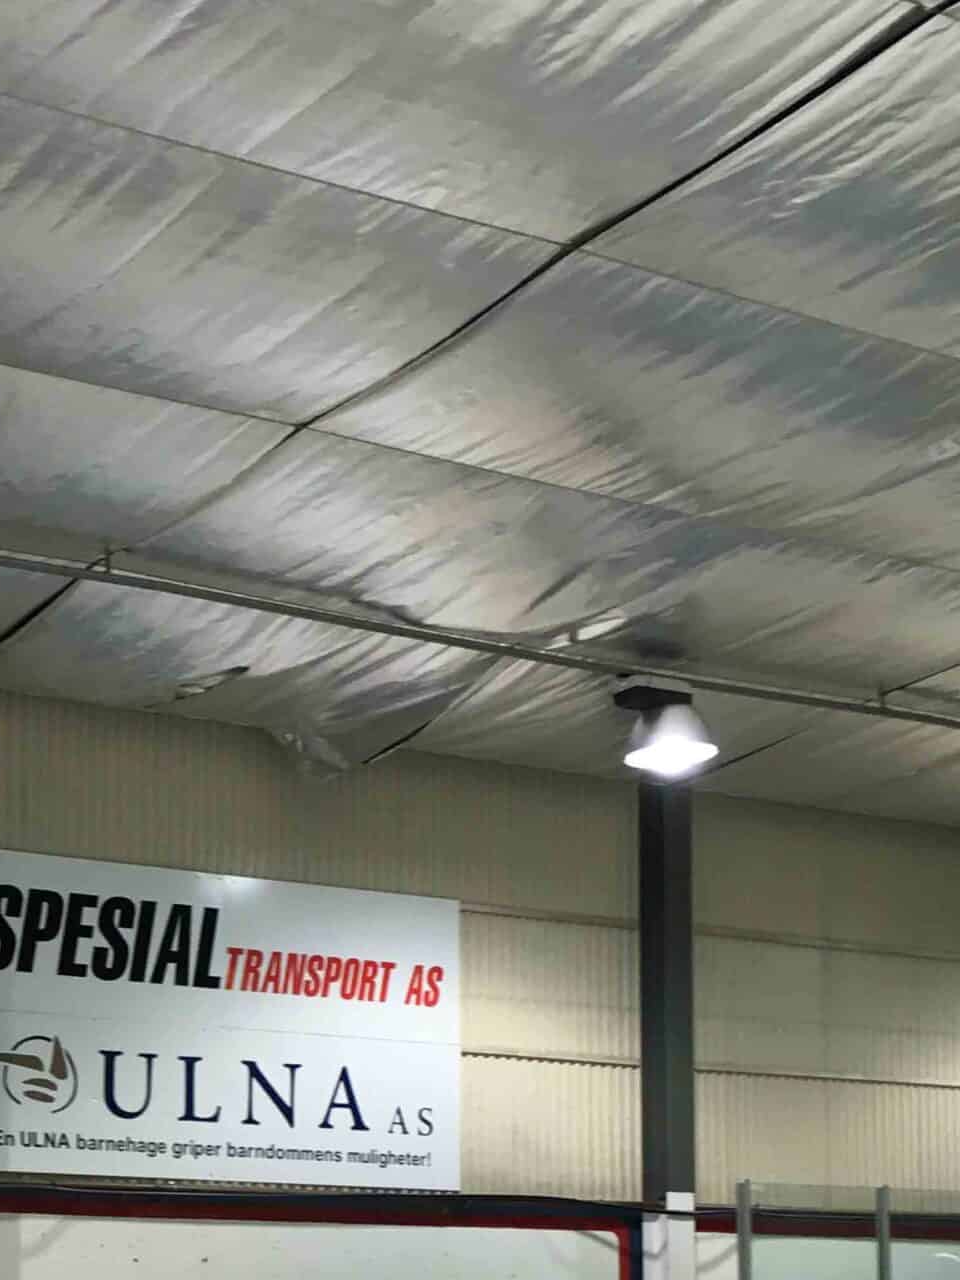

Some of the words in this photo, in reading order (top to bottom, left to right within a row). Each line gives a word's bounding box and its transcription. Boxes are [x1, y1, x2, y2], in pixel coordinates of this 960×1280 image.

[223, 946, 396, 1004] TRANSPORT
[404, 965, 445, 1007] AS
[98, 1049, 370, 1132] ULNA
[388, 1105, 434, 1137] AS
[20, 1131, 70, 1149] ULNA
[76, 1134, 167, 1158] barnehage
[171, 1140, 223, 1159] griper
[226, 1142, 342, 1163] barndommens
[346, 1149, 433, 1169] muligheter!
